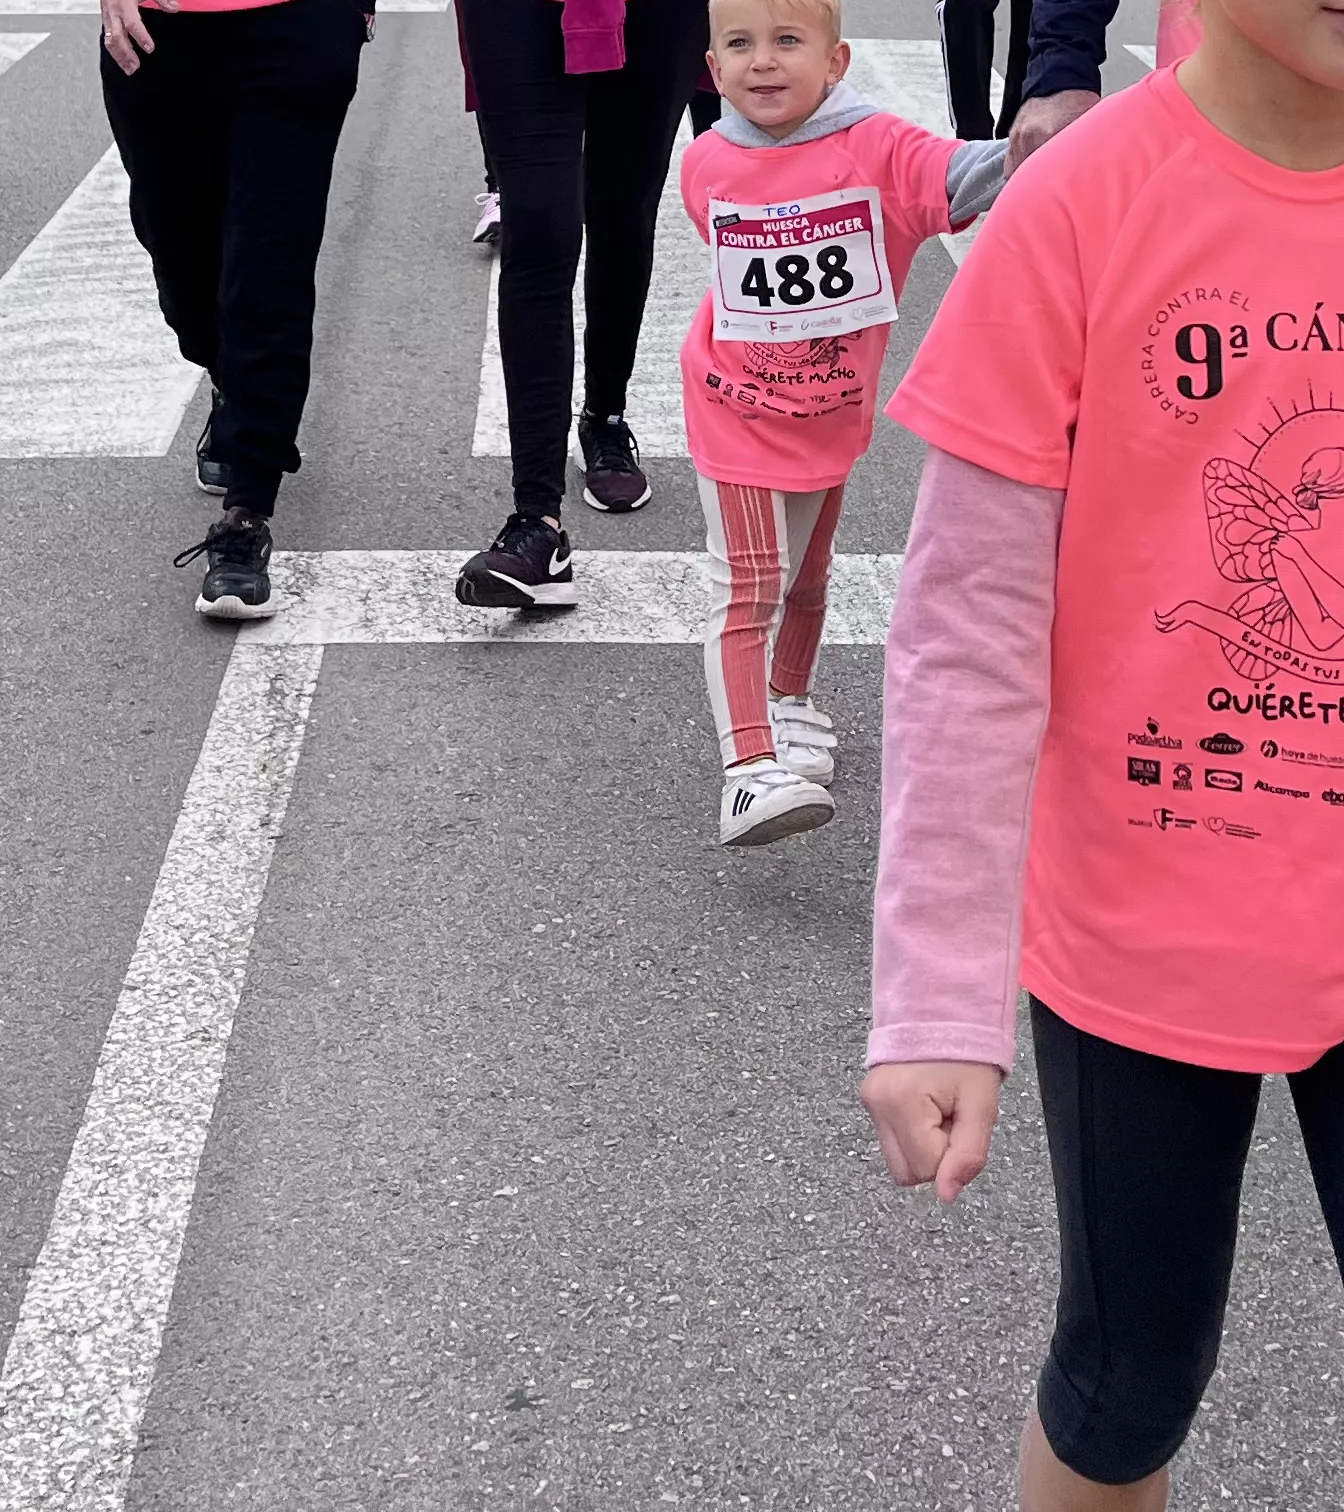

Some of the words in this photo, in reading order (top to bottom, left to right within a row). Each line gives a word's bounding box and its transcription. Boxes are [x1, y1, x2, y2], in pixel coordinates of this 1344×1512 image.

[762, 204, 801, 218] TEO
[762, 217, 809, 233] HUESCA
[721, 231, 777, 248] CONTRA
[781, 233, 799, 245] EL
[803, 217, 864, 242] CÁNCER
[740, 245, 855, 307] 488
[1147, 287, 1223, 337] CONTRA
[1229, 290, 1250, 313] EL
[809, 367, 856, 384] MUCHO
[1175, 323, 1248, 400] 9ª
[1141, 343, 1199, 425] CARRERA
[1313, 666, 1340, 680] TUS
